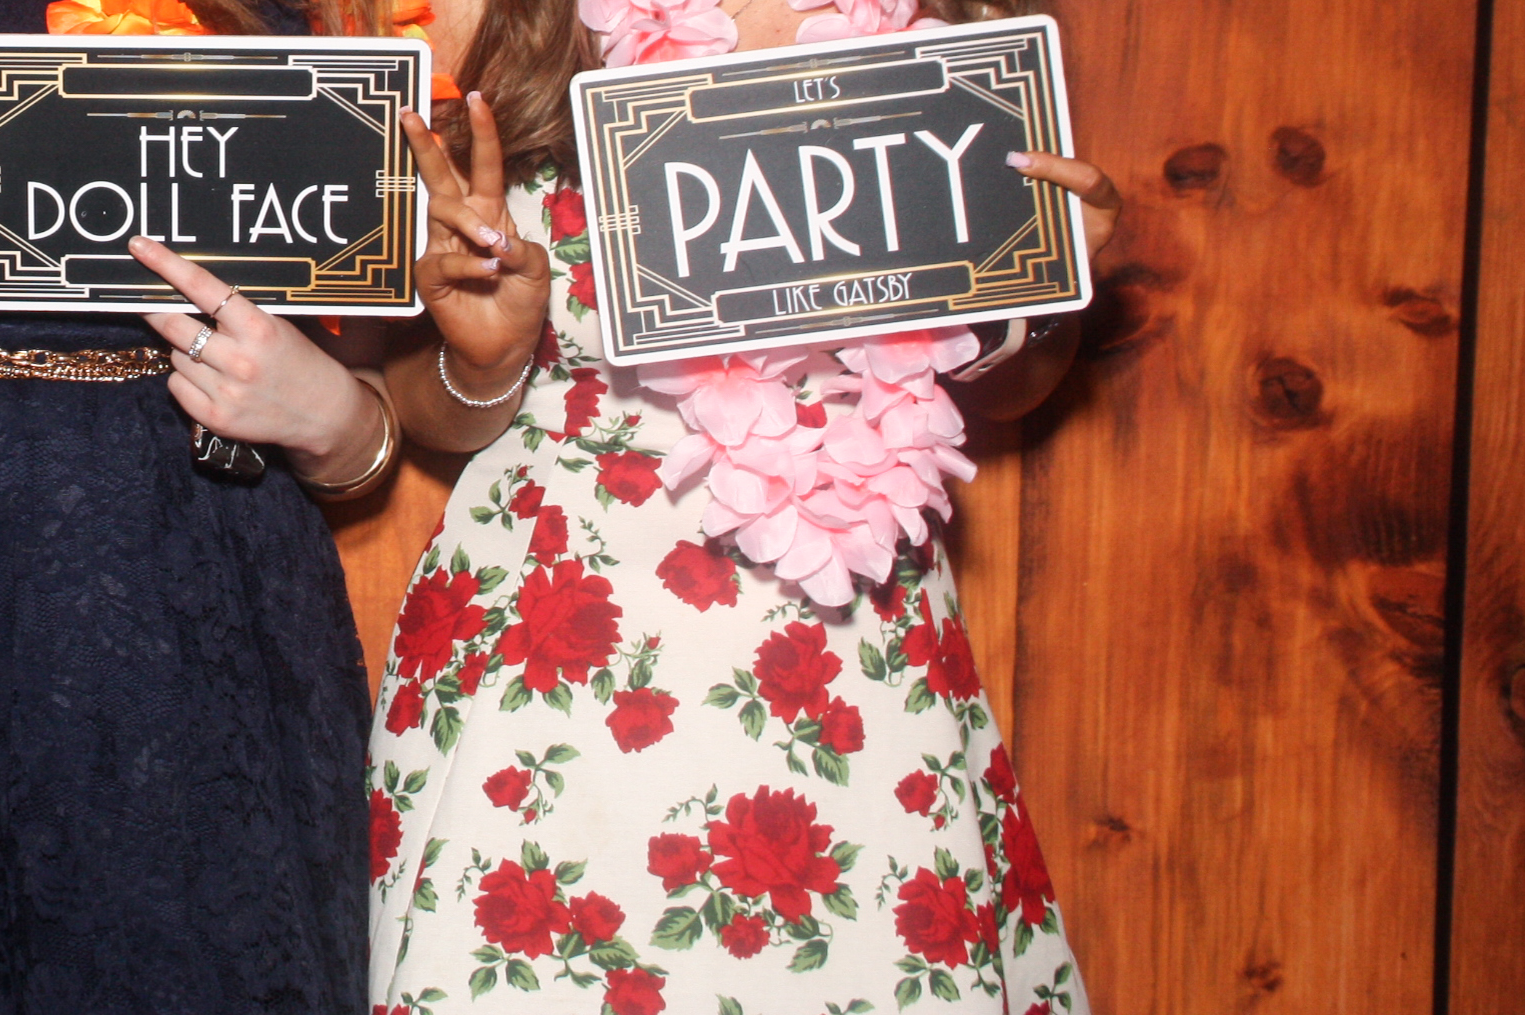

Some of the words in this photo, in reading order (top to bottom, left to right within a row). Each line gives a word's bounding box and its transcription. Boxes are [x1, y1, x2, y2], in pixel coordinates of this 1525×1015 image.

[794, 75, 841, 104] LET'S
[139, 125, 239, 179] HEY
[27, 180, 197, 243] DOLL
[230, 182, 349, 245] FACE
[663, 123, 984, 278] PARTY
[772, 282, 822, 317] LIKE
[833, 272, 913, 308] GATSBY
